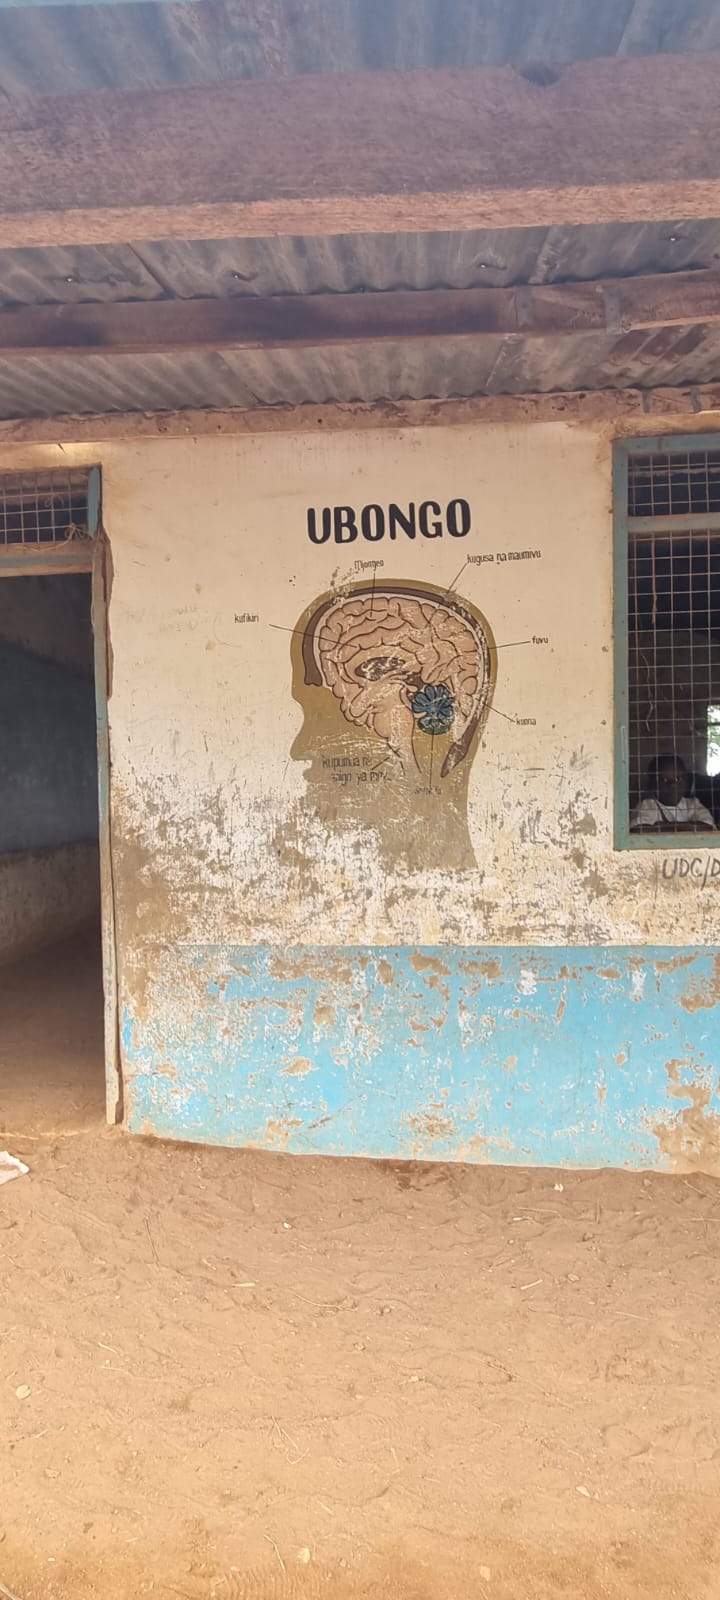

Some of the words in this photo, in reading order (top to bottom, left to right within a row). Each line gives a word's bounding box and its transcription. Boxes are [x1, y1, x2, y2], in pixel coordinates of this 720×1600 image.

[307, 498, 472, 544] UBONGO
[496, 553, 507, 562] na
[531, 635, 549, 644] fuvu
[516, 717, 537, 726] kuona
